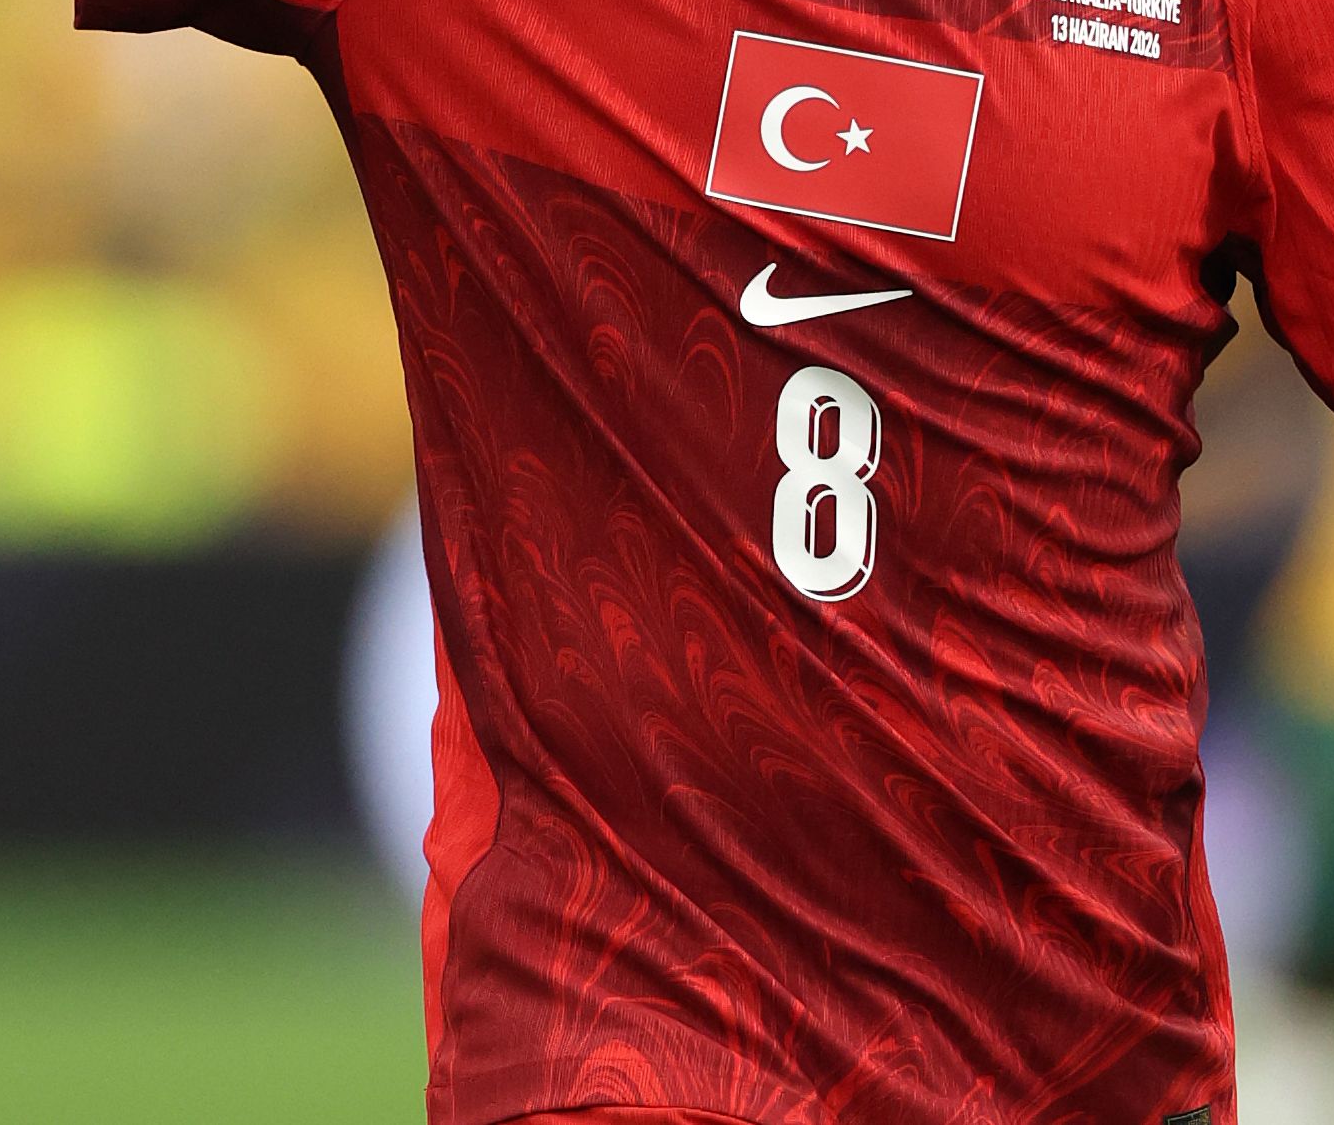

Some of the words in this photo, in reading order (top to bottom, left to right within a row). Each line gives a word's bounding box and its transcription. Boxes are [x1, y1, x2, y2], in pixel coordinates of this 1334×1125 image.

[1051, 15, 1068, 42] 13
[1069, 16, 1129, 53] HAZİRAN
[1130, 28, 1161, 59] 2026
[772, 366, 882, 602] 8
